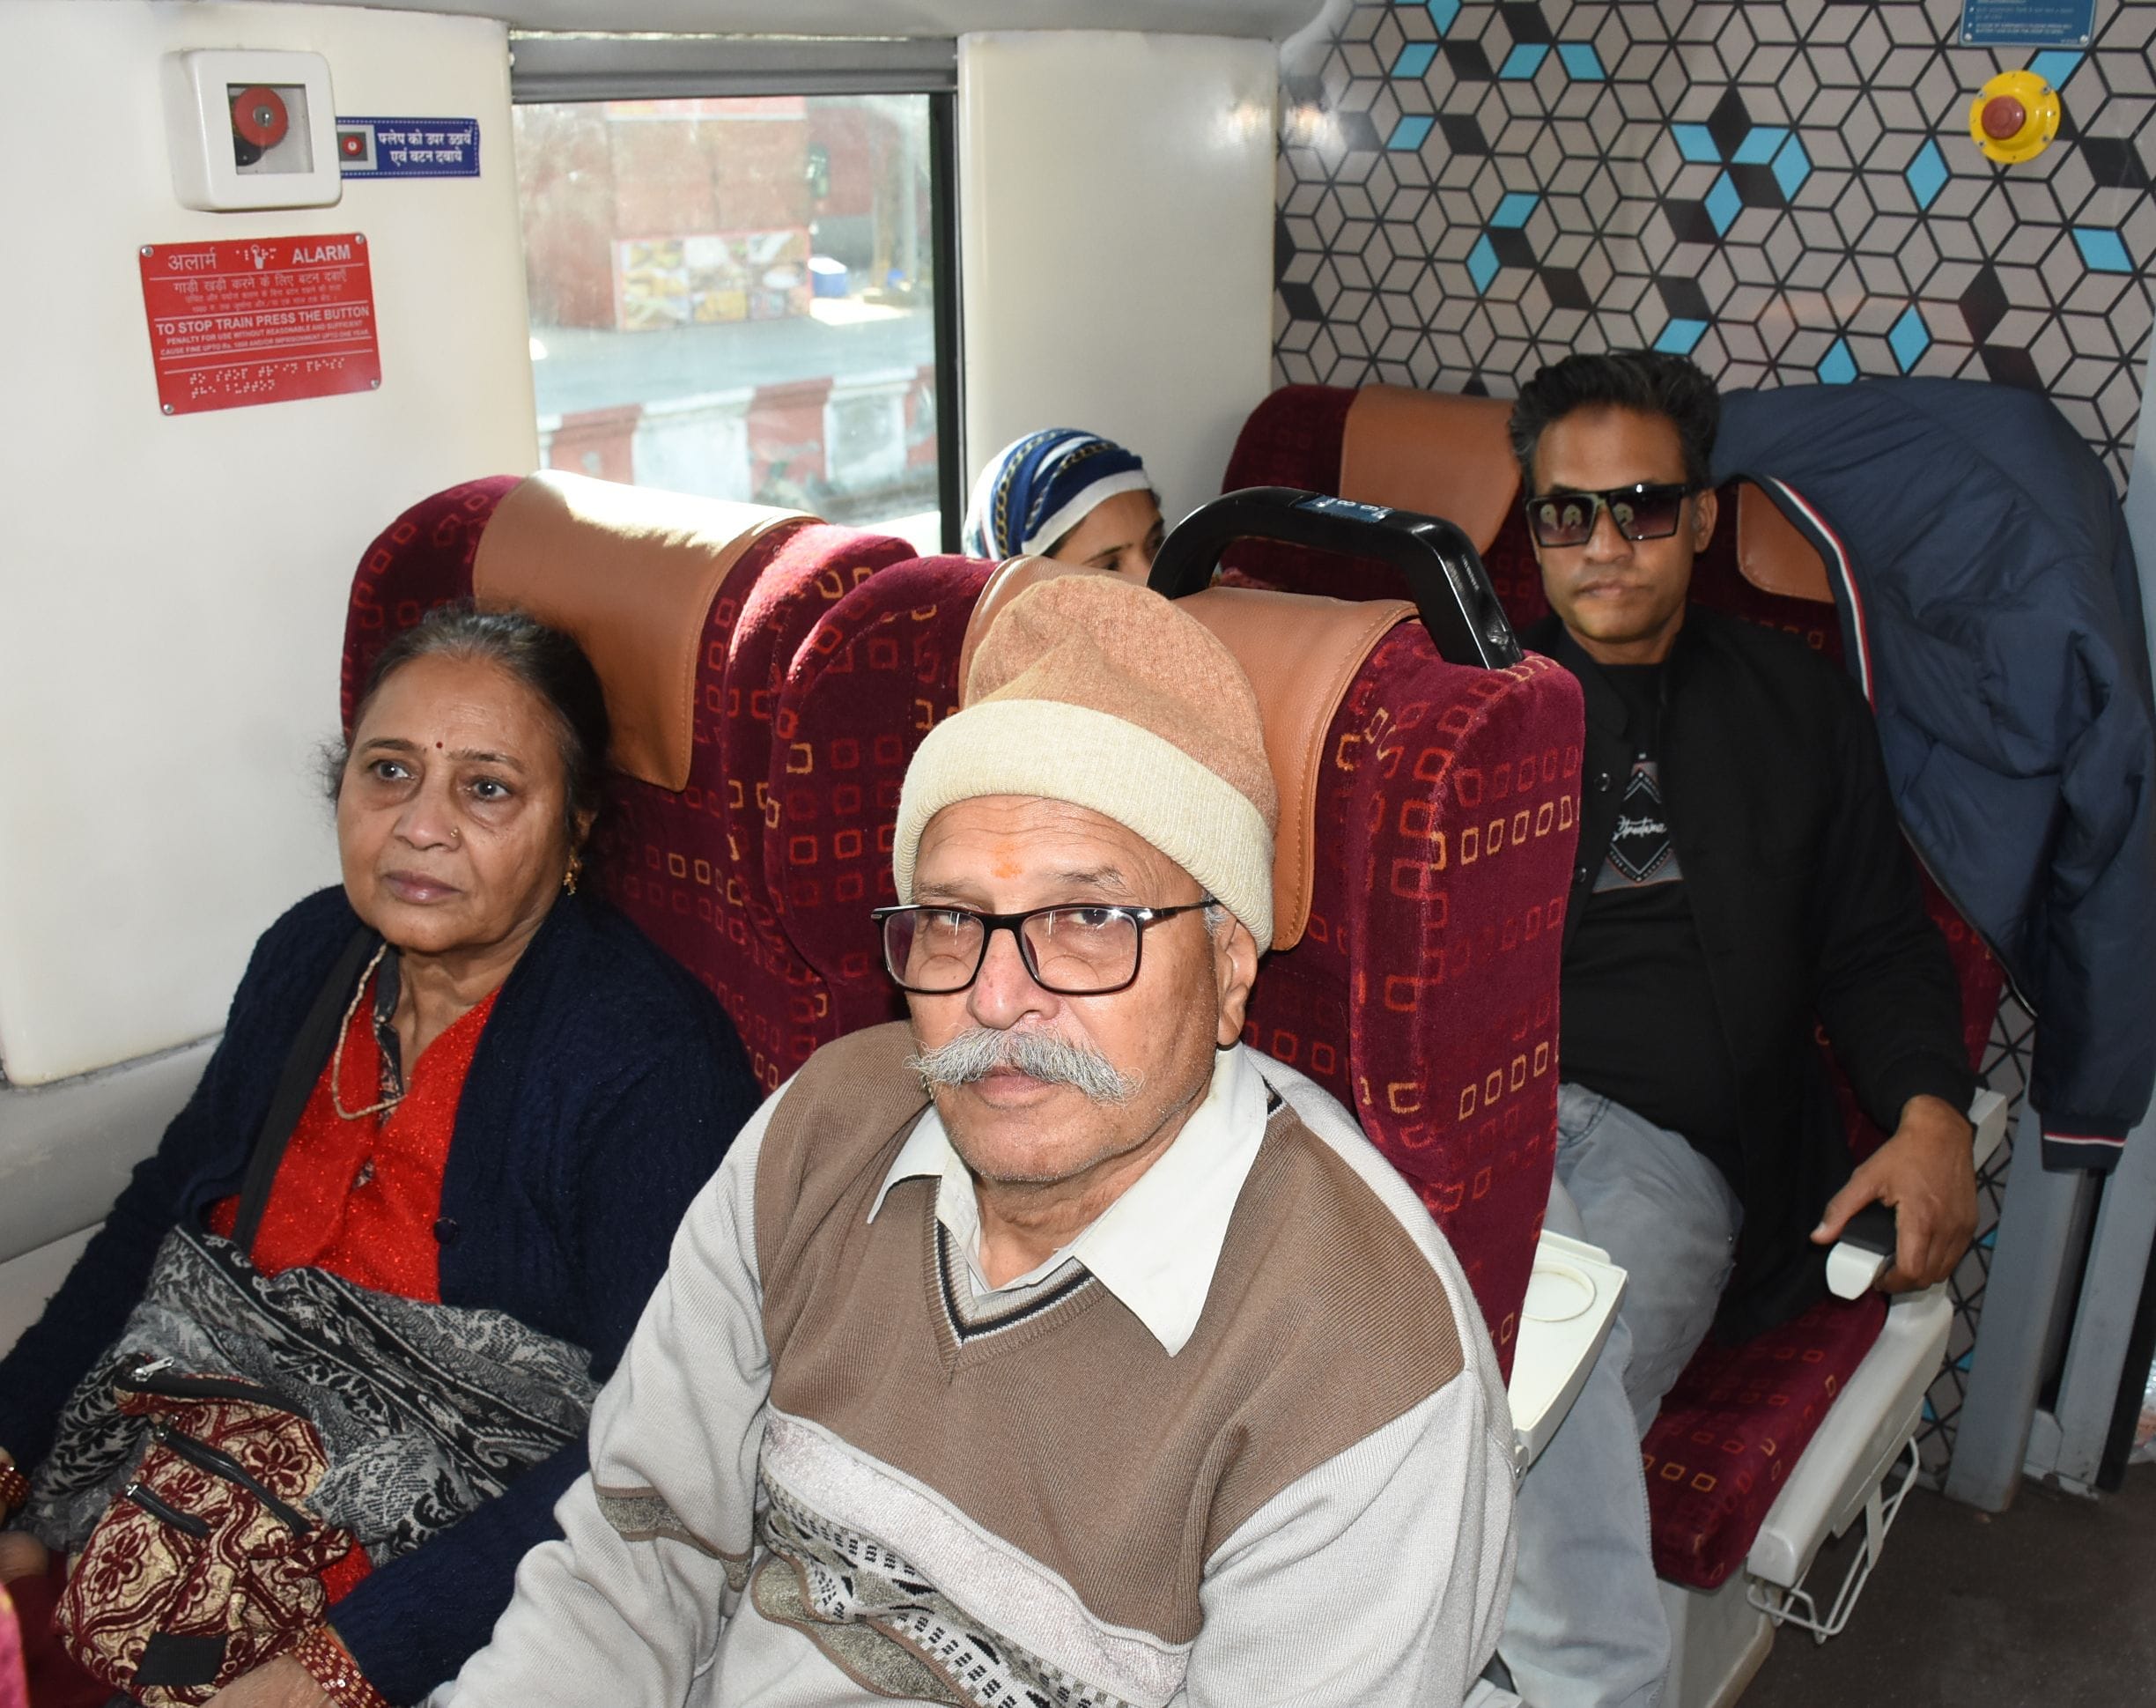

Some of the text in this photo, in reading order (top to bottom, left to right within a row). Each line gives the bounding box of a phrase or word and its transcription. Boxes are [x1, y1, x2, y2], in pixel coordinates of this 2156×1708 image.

[407, 129, 423, 145] को
[167, 247, 217, 270] अलार्म
[292, 244, 351, 264] ALARM
[156, 306, 369, 336] TO STOP TRAIN PRESS THE BUTTON
[166, 336, 200, 345] PENALTY
[201, 334, 217, 343] FOR
